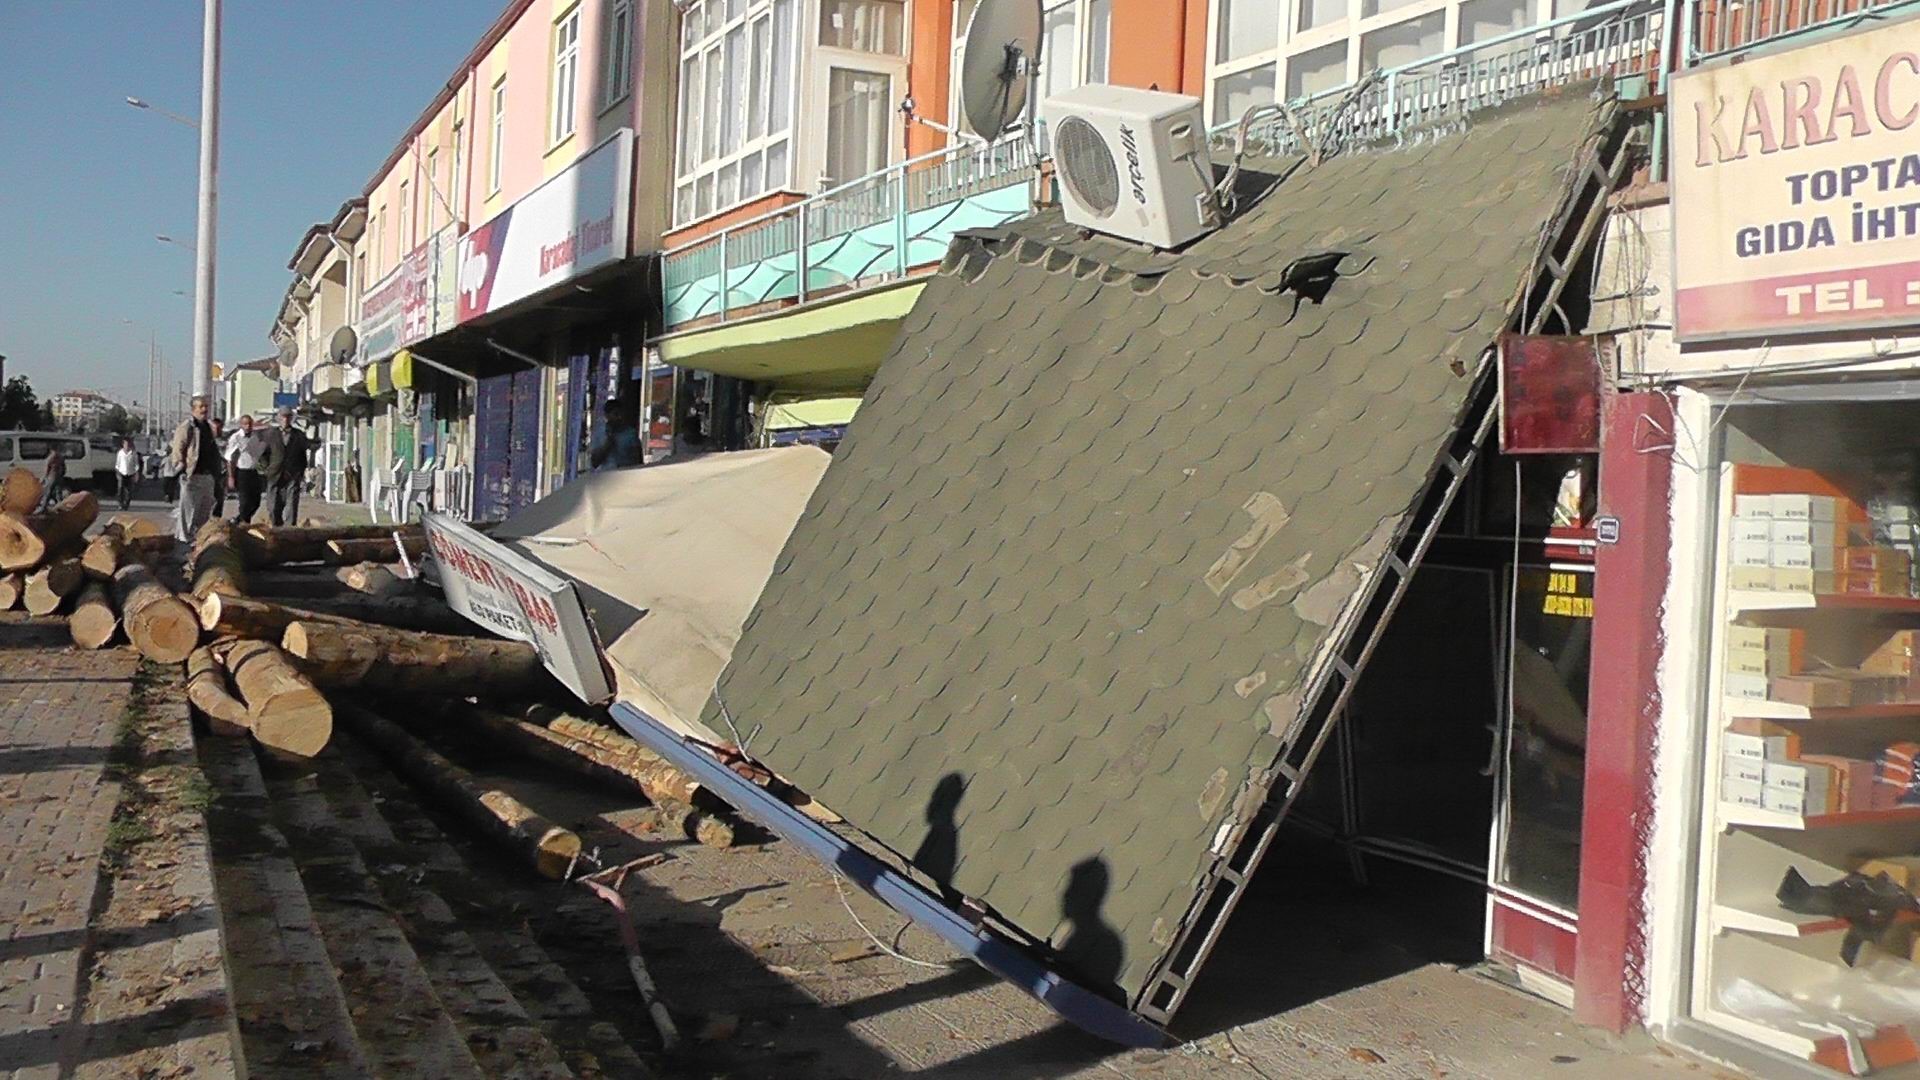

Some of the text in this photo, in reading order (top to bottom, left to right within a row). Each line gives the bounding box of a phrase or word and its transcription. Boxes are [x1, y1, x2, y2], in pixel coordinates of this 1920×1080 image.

[1694, 52, 1920, 167] KARAC
[1120, 123, 1146, 204] arçelik
[1785, 154, 1920, 205] TOPTA
[1736, 202, 1920, 258] GIDA İHT
[1776, 279, 1884, 315] TEL
